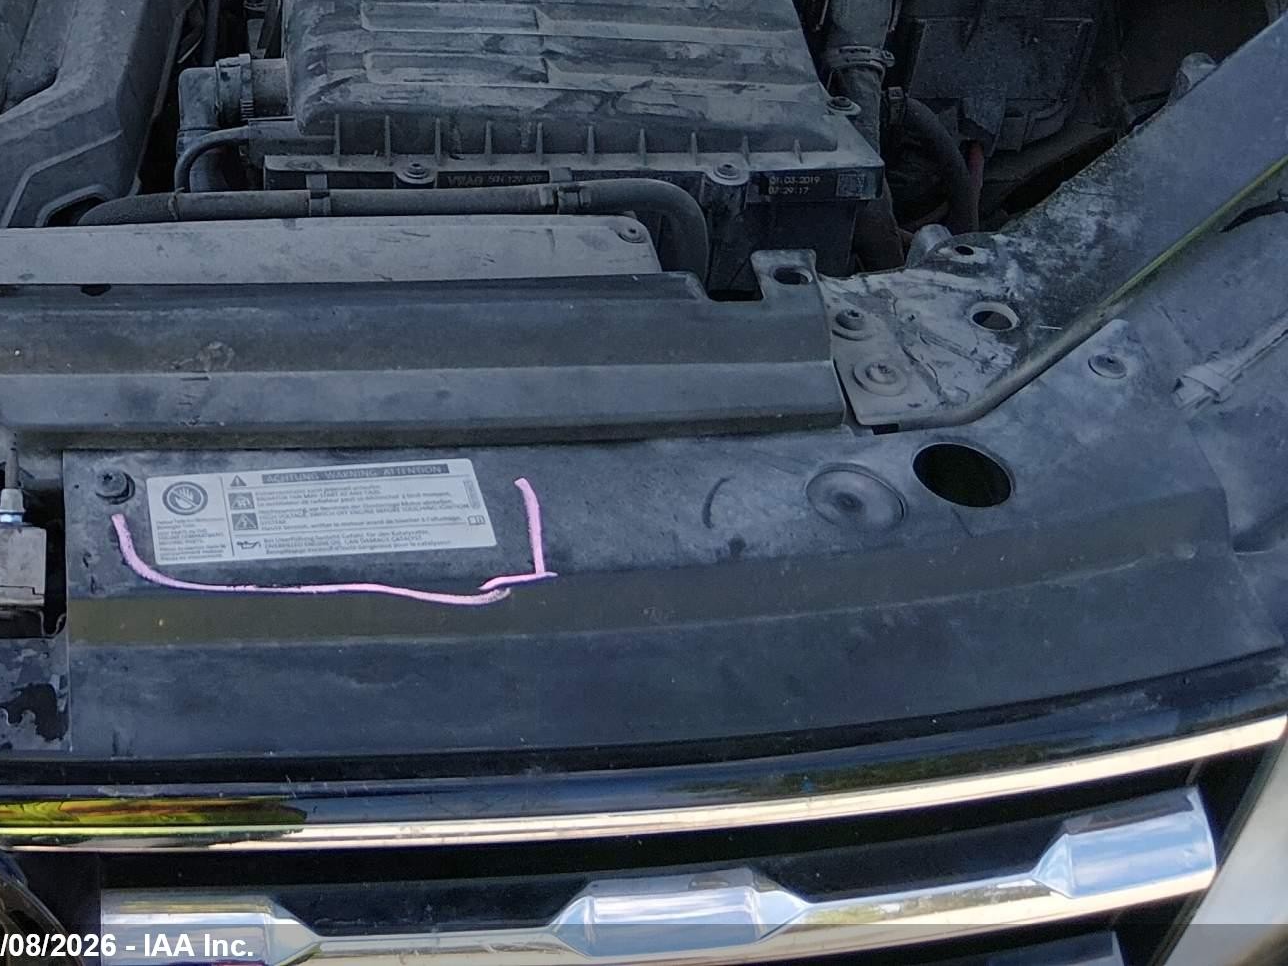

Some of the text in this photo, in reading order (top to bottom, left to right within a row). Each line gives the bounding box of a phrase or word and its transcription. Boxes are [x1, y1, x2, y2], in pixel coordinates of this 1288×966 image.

[266, 465, 443, 484] ACHTUNG WARNING ATTENTION
